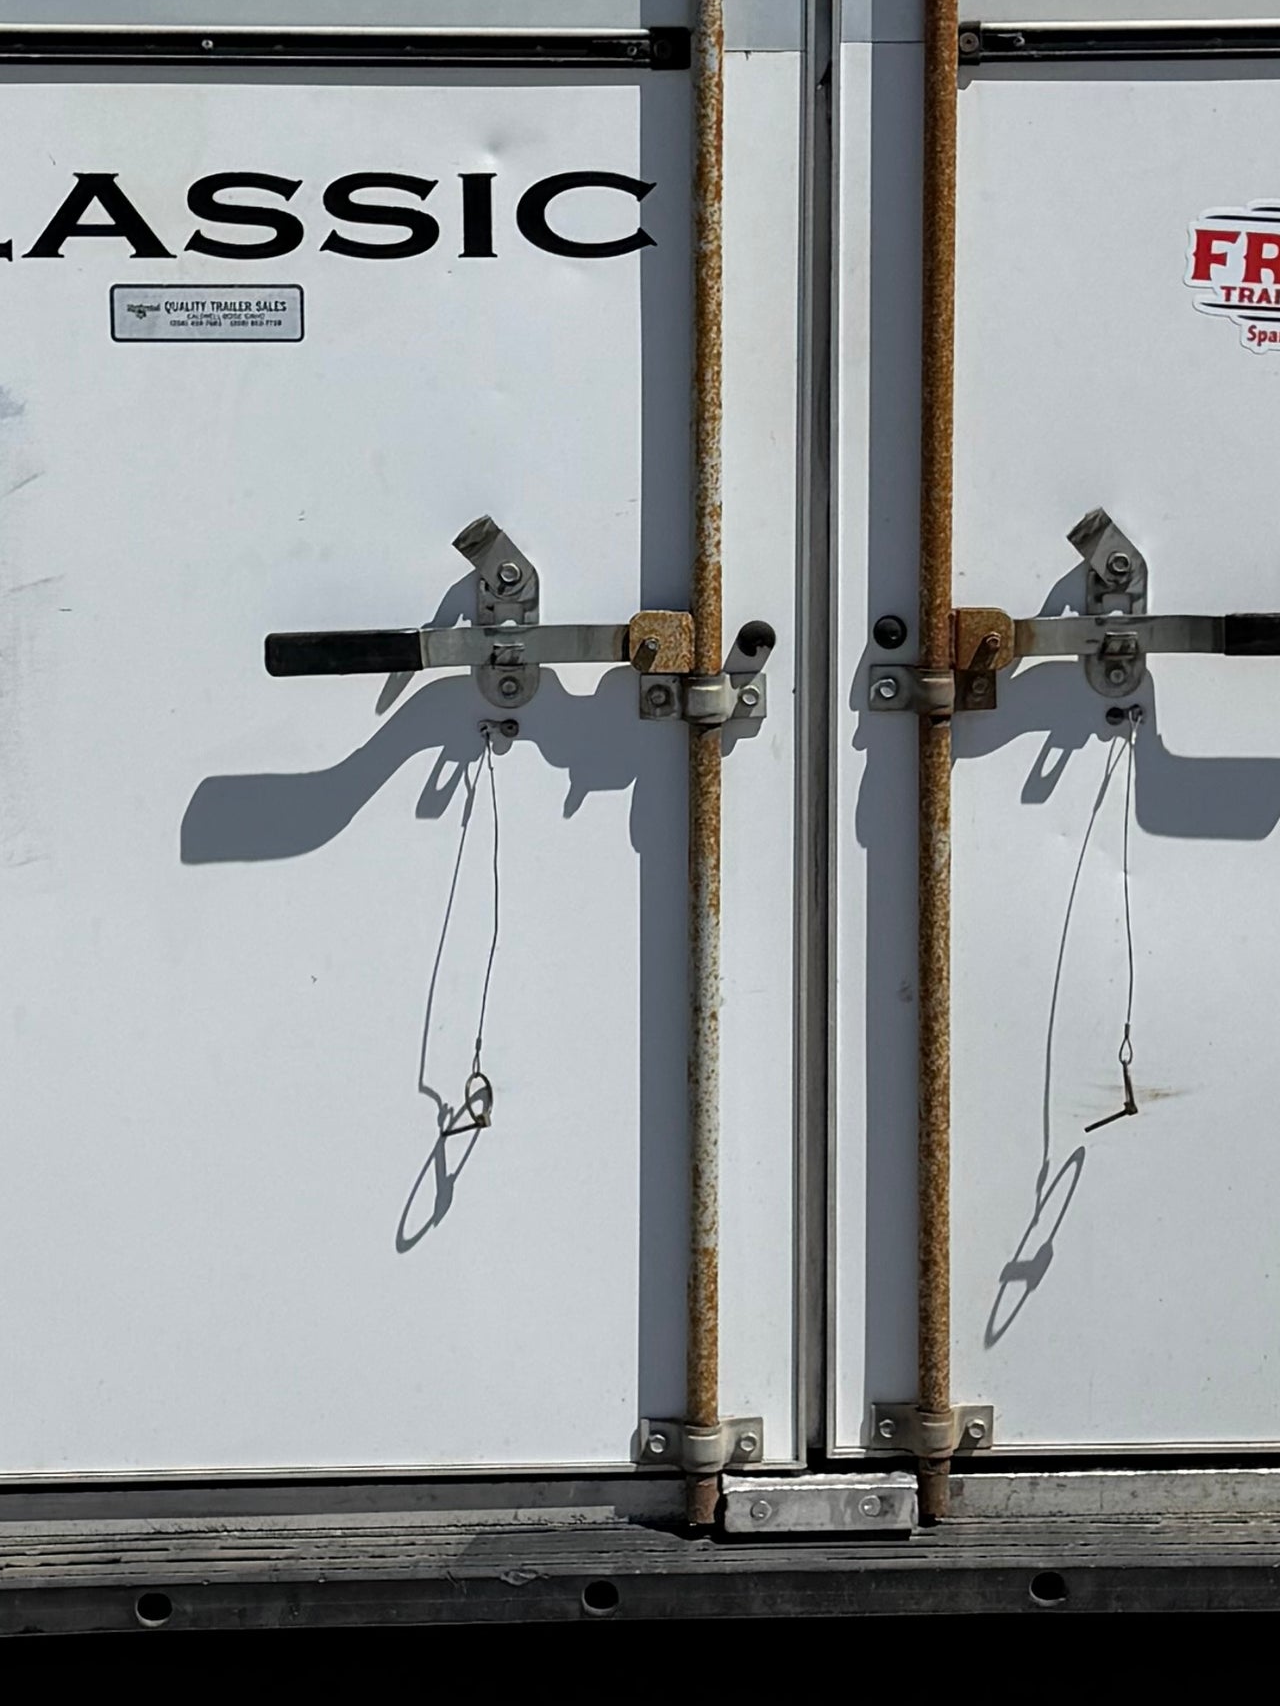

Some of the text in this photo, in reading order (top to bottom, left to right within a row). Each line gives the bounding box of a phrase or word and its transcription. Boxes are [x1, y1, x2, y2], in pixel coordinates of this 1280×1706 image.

[164, 300, 206, 314] QUALITY
[211, 300, 252, 312] TRAILER
[255, 300, 287, 312] SALES
